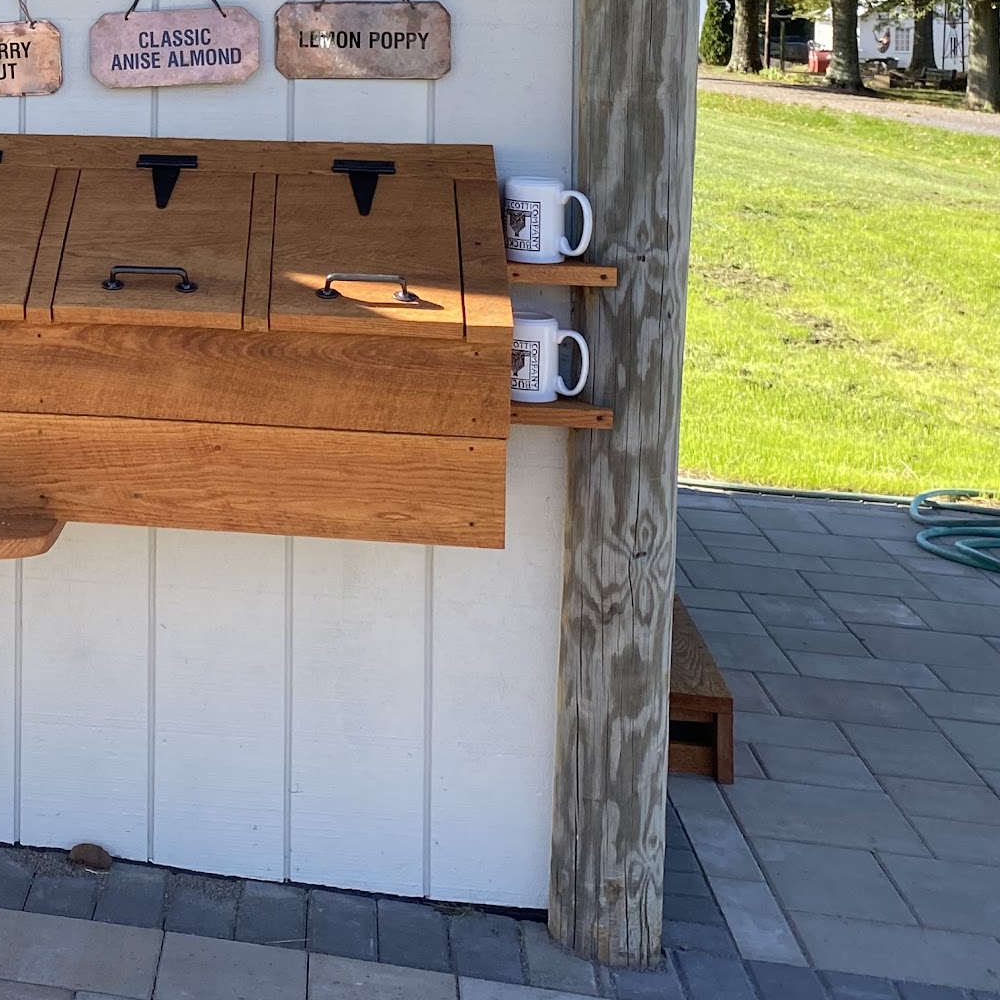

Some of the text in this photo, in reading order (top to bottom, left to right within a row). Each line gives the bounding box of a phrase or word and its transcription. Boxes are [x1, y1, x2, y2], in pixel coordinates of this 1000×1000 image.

[138, 27, 212, 49] CLASSIC
[369, 31, 430, 50] POPPY
[111, 47, 242, 71] ANISE ALMOND
